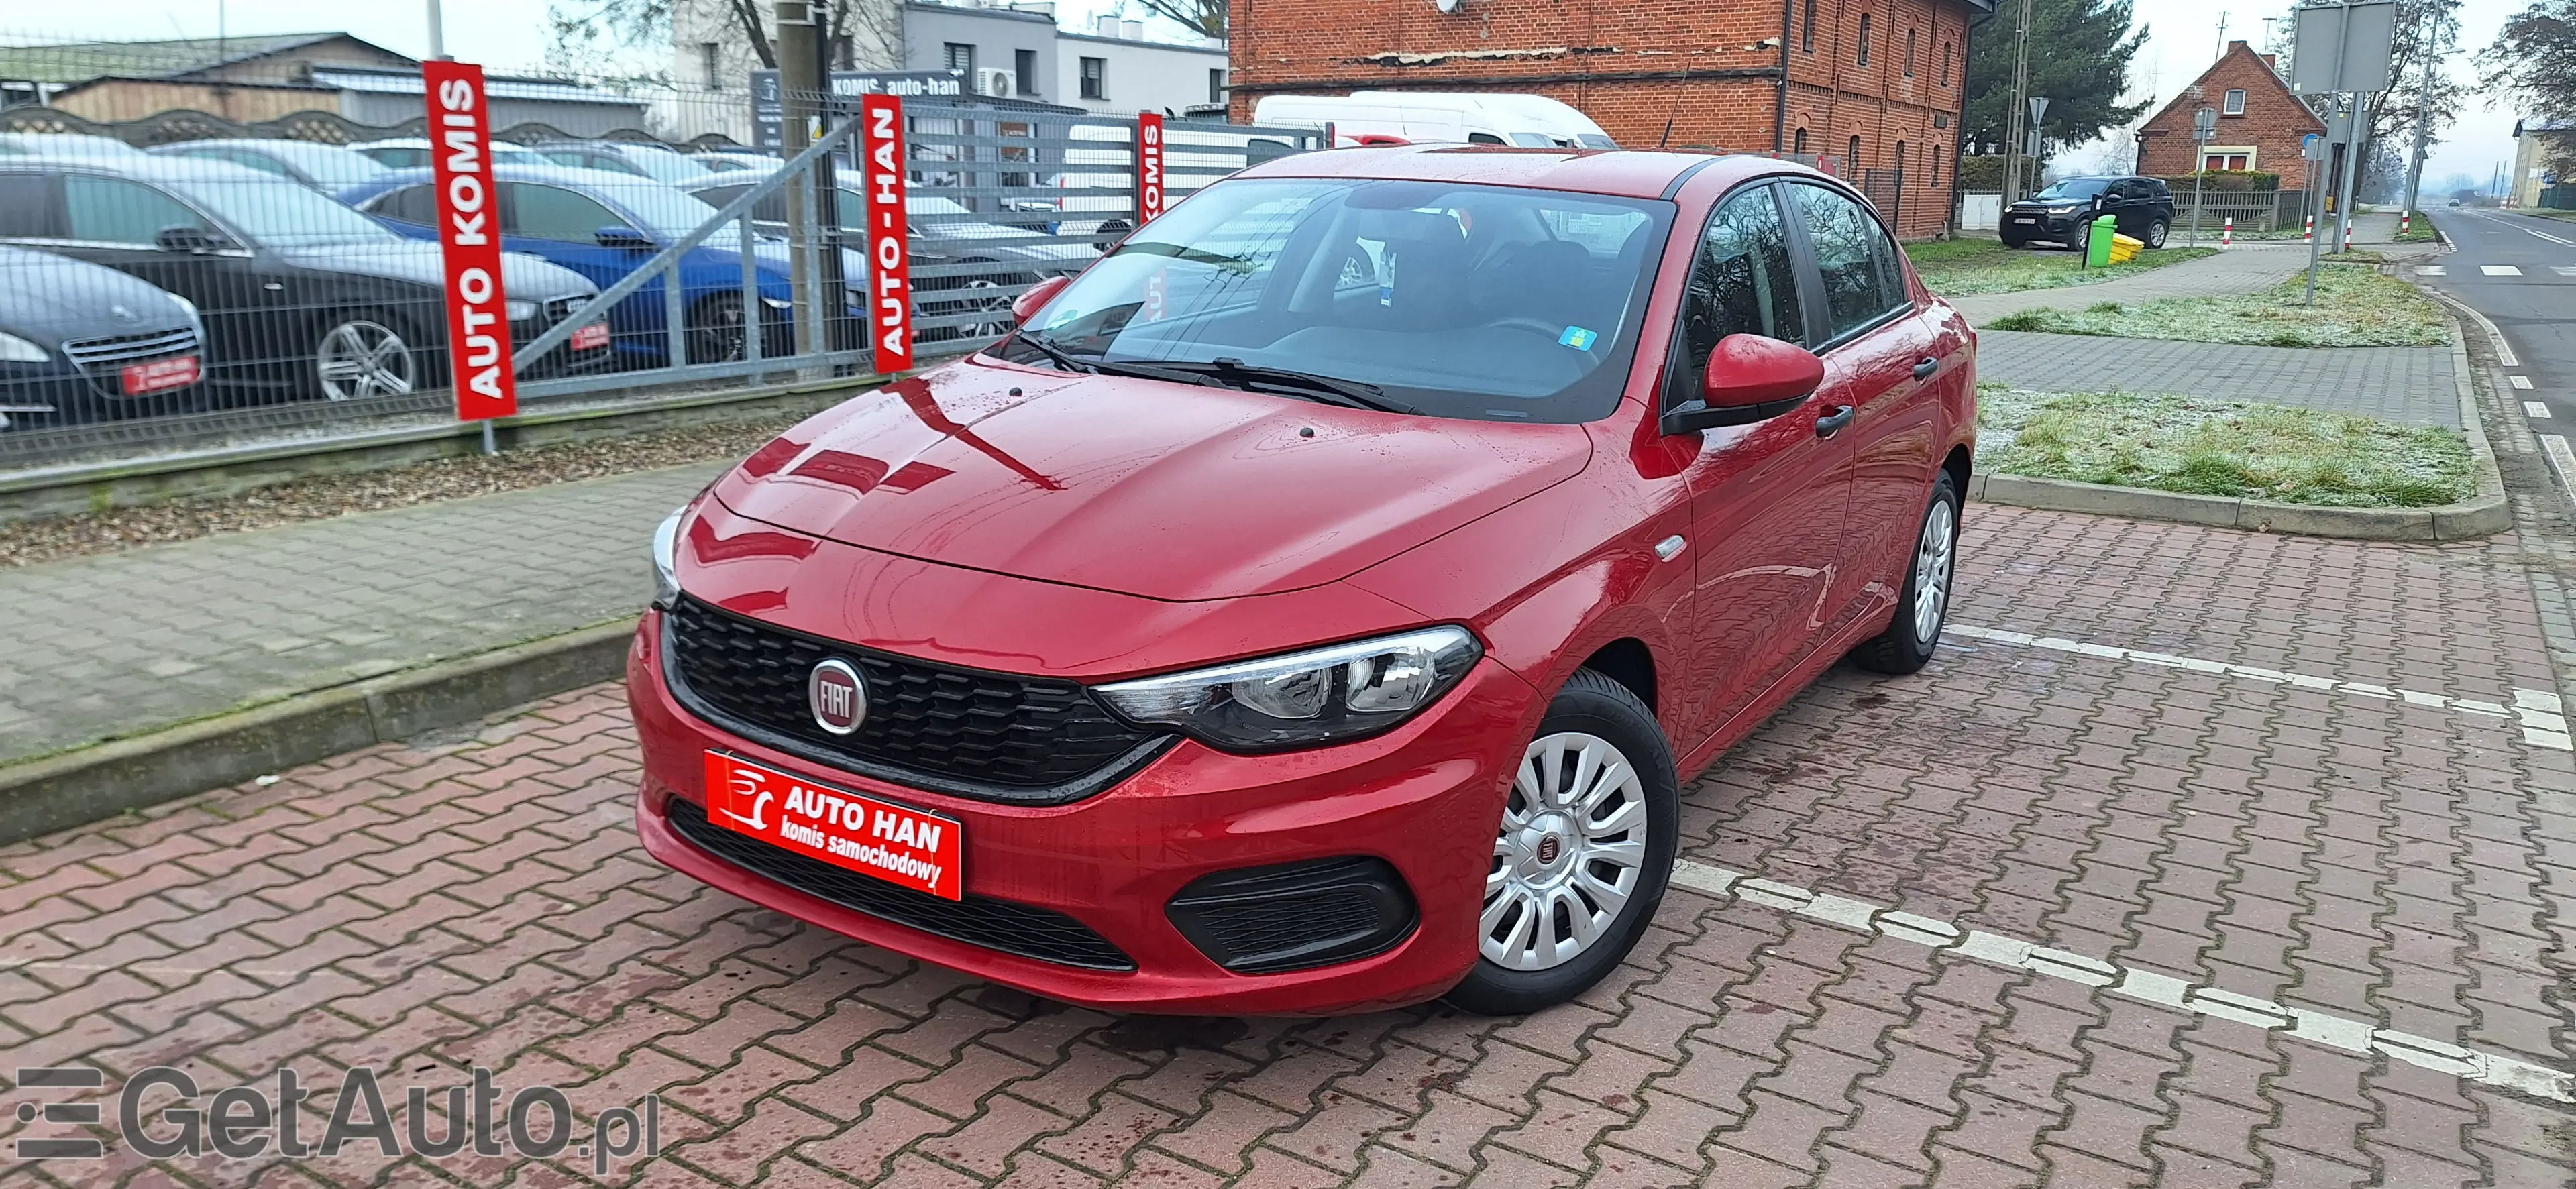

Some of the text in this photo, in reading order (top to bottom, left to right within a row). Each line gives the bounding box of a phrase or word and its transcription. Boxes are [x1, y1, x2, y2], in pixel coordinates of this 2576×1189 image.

[887, 78, 960, 96] auto-han
[439, 79, 504, 400] AUTO KOMIS
[820, 679, 853, 718] FIAT
[783, 785, 942, 853] AUTO HAN
[780, 815, 943, 889] komis samochodowy
[1542, 842, 1554, 858] FIAT
